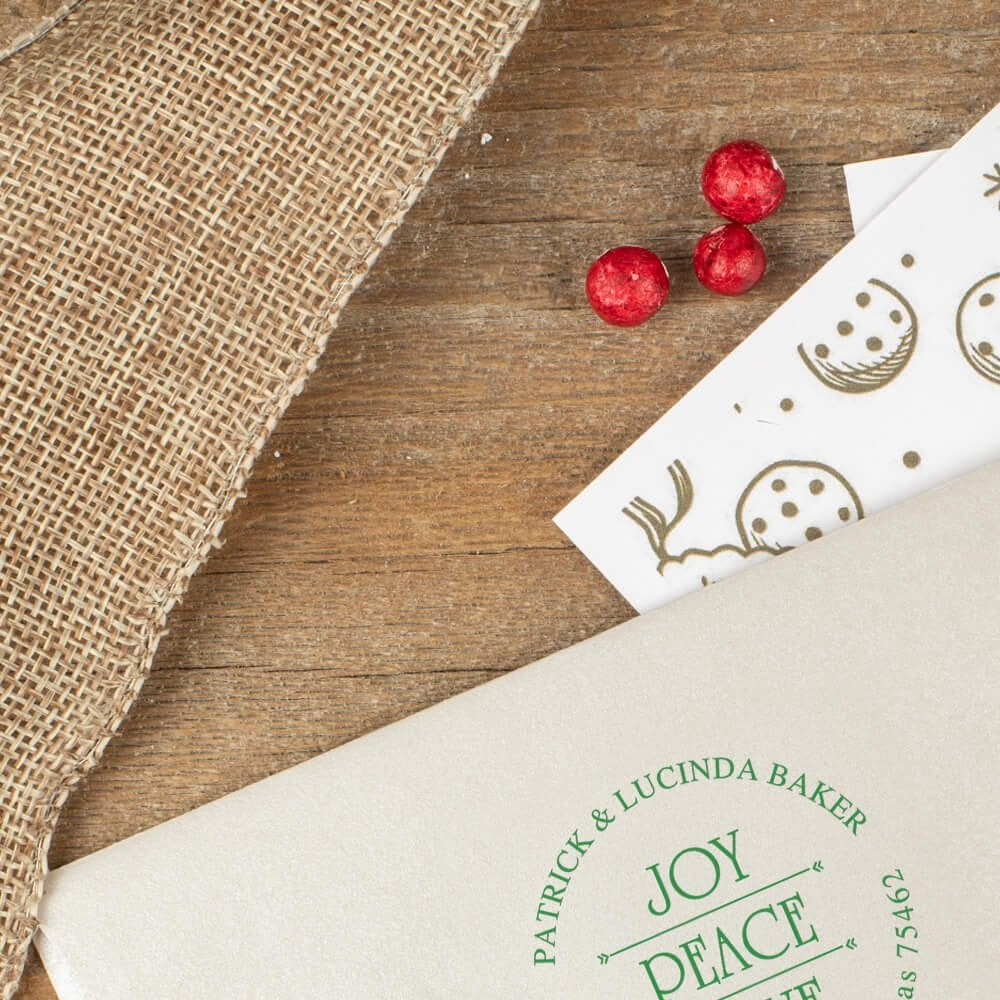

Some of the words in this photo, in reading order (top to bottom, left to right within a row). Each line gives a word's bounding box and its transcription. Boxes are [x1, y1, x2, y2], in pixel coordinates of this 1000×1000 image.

[532, 829, 594, 966] PATRICK
[591, 807, 616, 832] &
[613, 756, 758, 812] LUCINDA
[767, 762, 868, 836] BAKER
[645, 828, 751, 917] JOY
[882, 868, 919, 959] 75462
